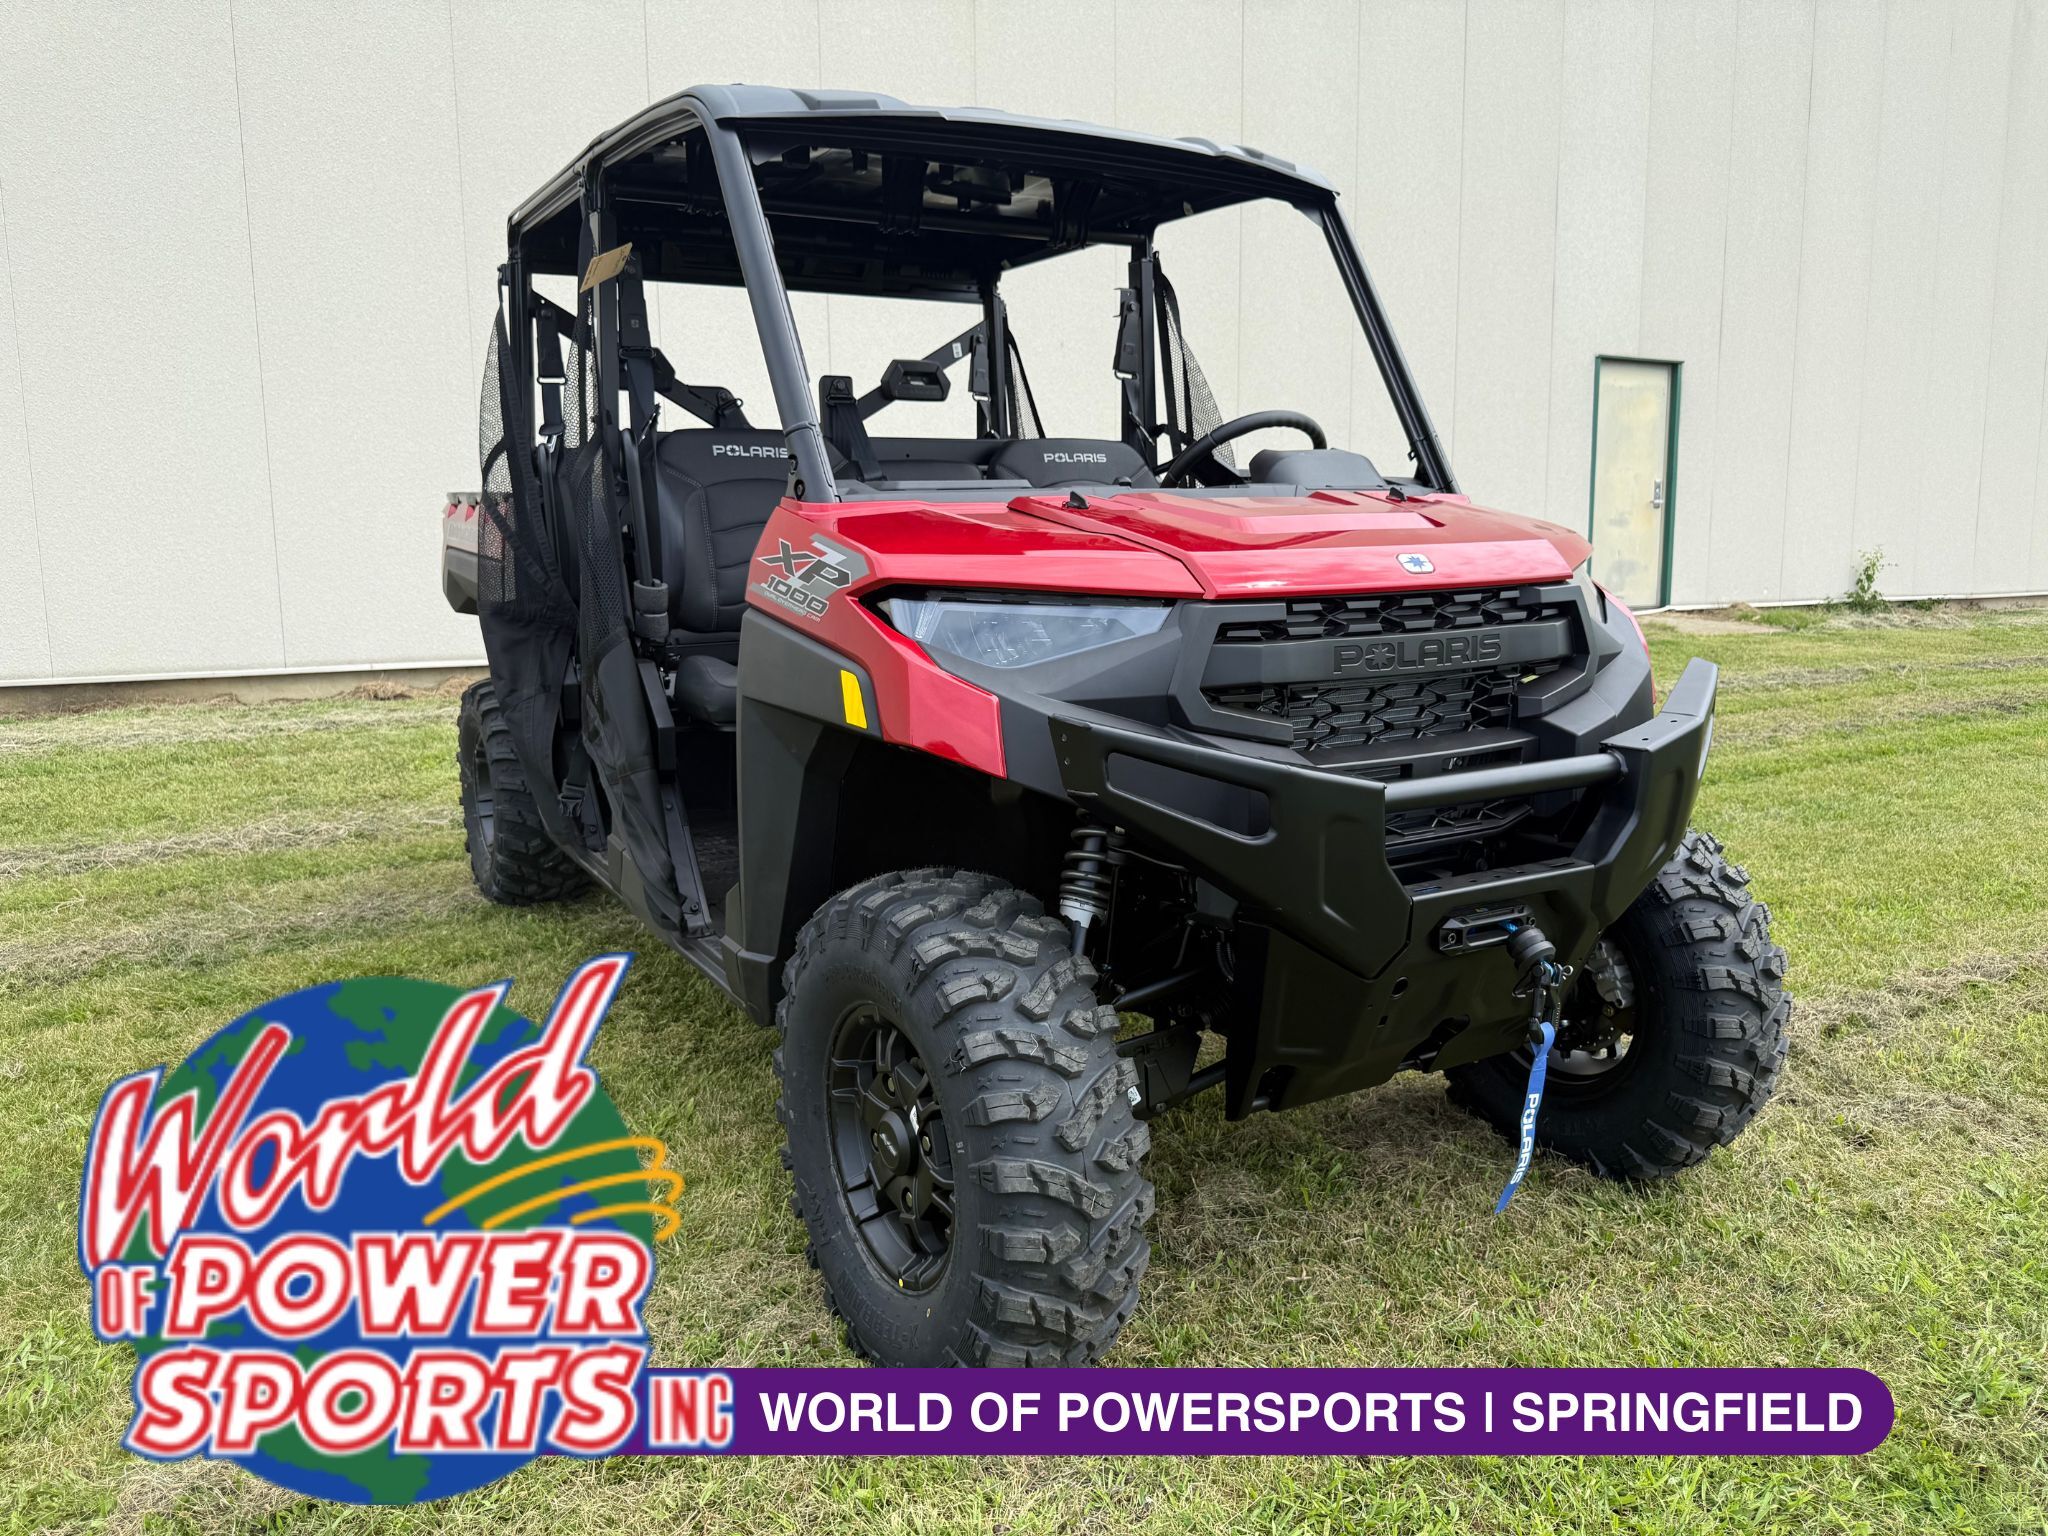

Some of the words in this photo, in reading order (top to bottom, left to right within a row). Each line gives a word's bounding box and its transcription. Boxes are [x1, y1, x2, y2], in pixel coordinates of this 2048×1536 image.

[712, 444, 788, 459] POLARIS
[1043, 452, 1107, 464] POLARIS
[757, 537, 852, 589] XP
[760, 574, 830, 618] 1000
[1333, 633, 1501, 675] POLARIS
[1509, 1093, 1540, 1185] POLARIS
